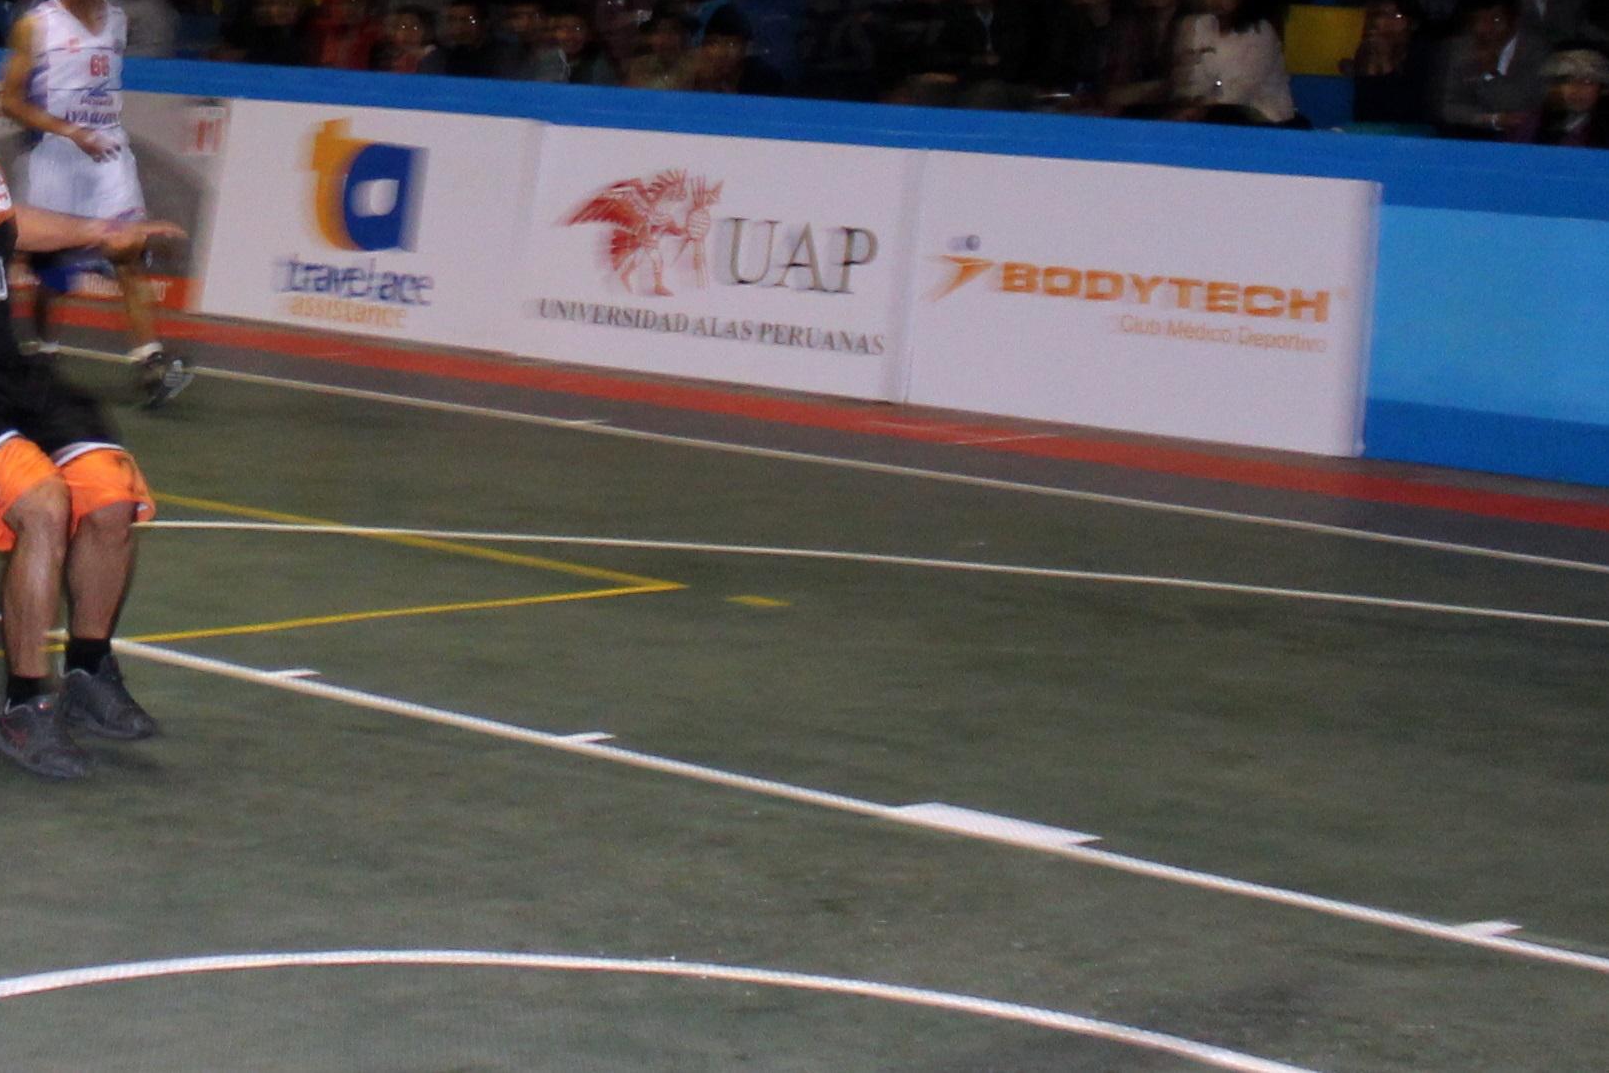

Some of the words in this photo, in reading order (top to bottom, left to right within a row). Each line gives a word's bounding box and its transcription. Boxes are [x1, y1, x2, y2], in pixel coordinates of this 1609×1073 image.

[724, 217, 878, 294] UAP
[1001, 261, 1331, 322] BODYTECH
[537, 298, 689, 333] UNIVERSIDAD
[692, 317, 752, 341] ALAS
[758, 323, 885, 355] PERUANAS
